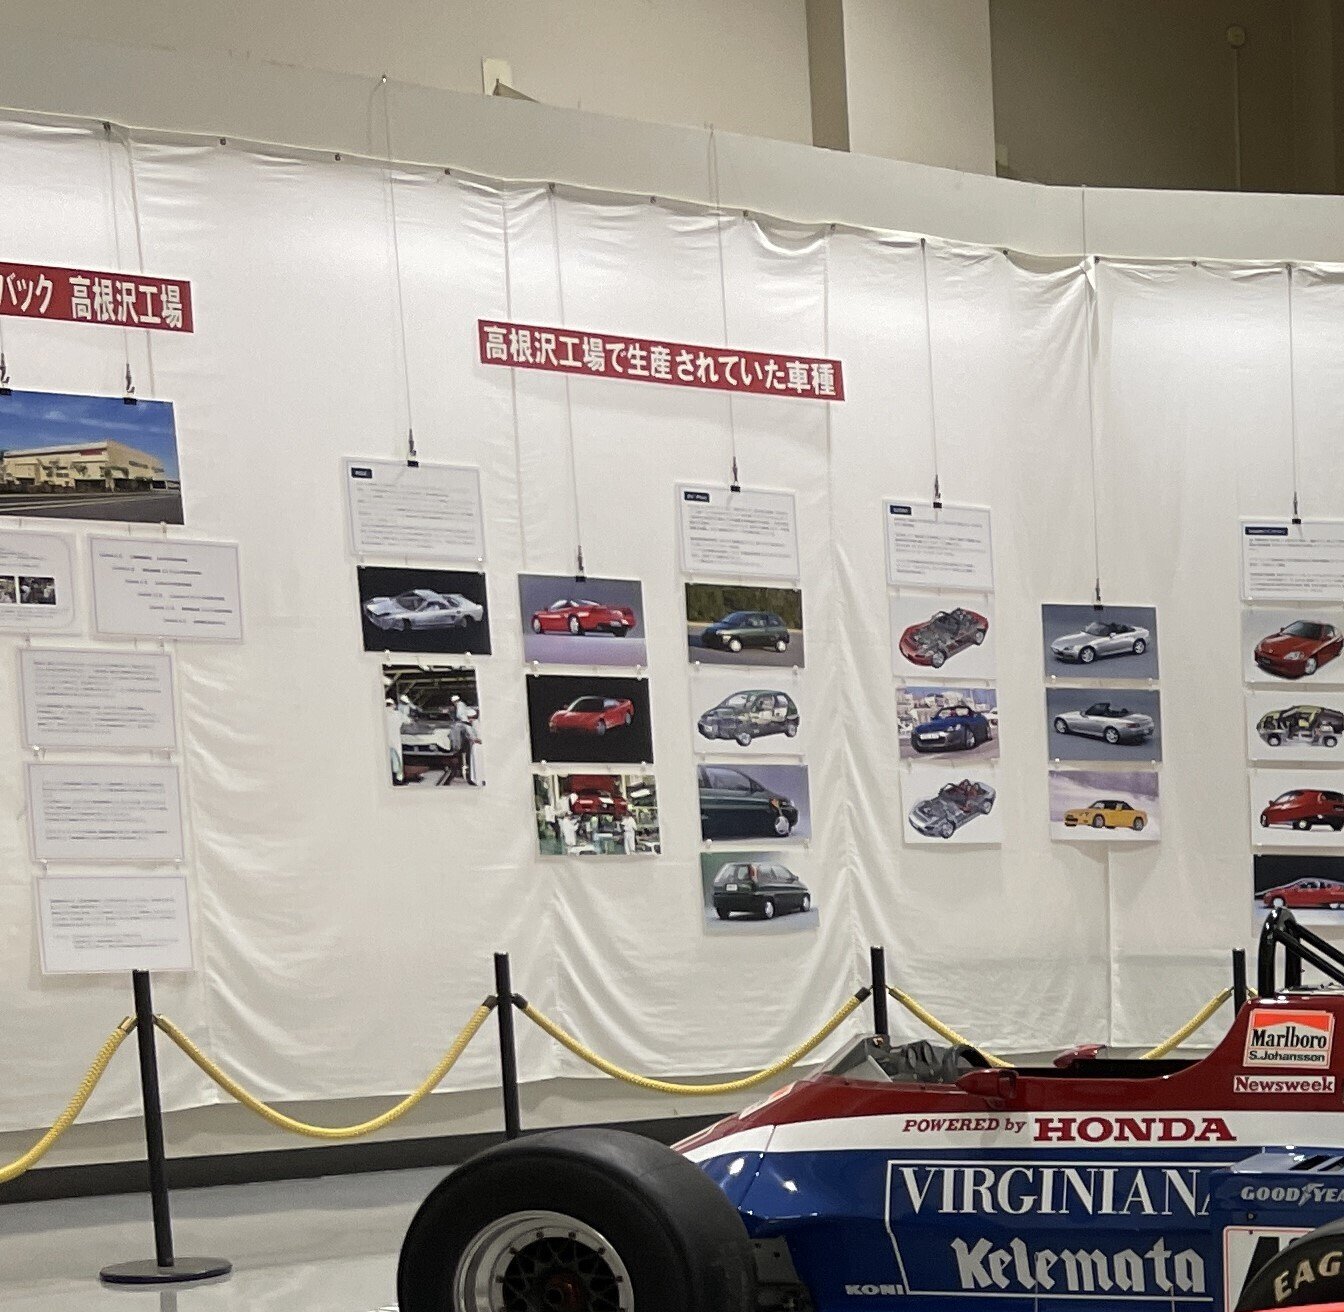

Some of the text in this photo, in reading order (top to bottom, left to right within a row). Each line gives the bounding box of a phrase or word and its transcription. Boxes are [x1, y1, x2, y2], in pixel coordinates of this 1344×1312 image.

[69, 275, 183, 328] 高根沢工場
[484, 325, 836, 397] 高根沢工場で生産されていた車種
[1251, 1022, 1328, 1050] Marlboro
[1235, 1076, 1334, 1093] Newsweek
[903, 1116, 1237, 1142] POWERED by HONDA
[950, 1236, 1206, 1292] Kelemata
[845, 1284, 906, 1296] KONI
